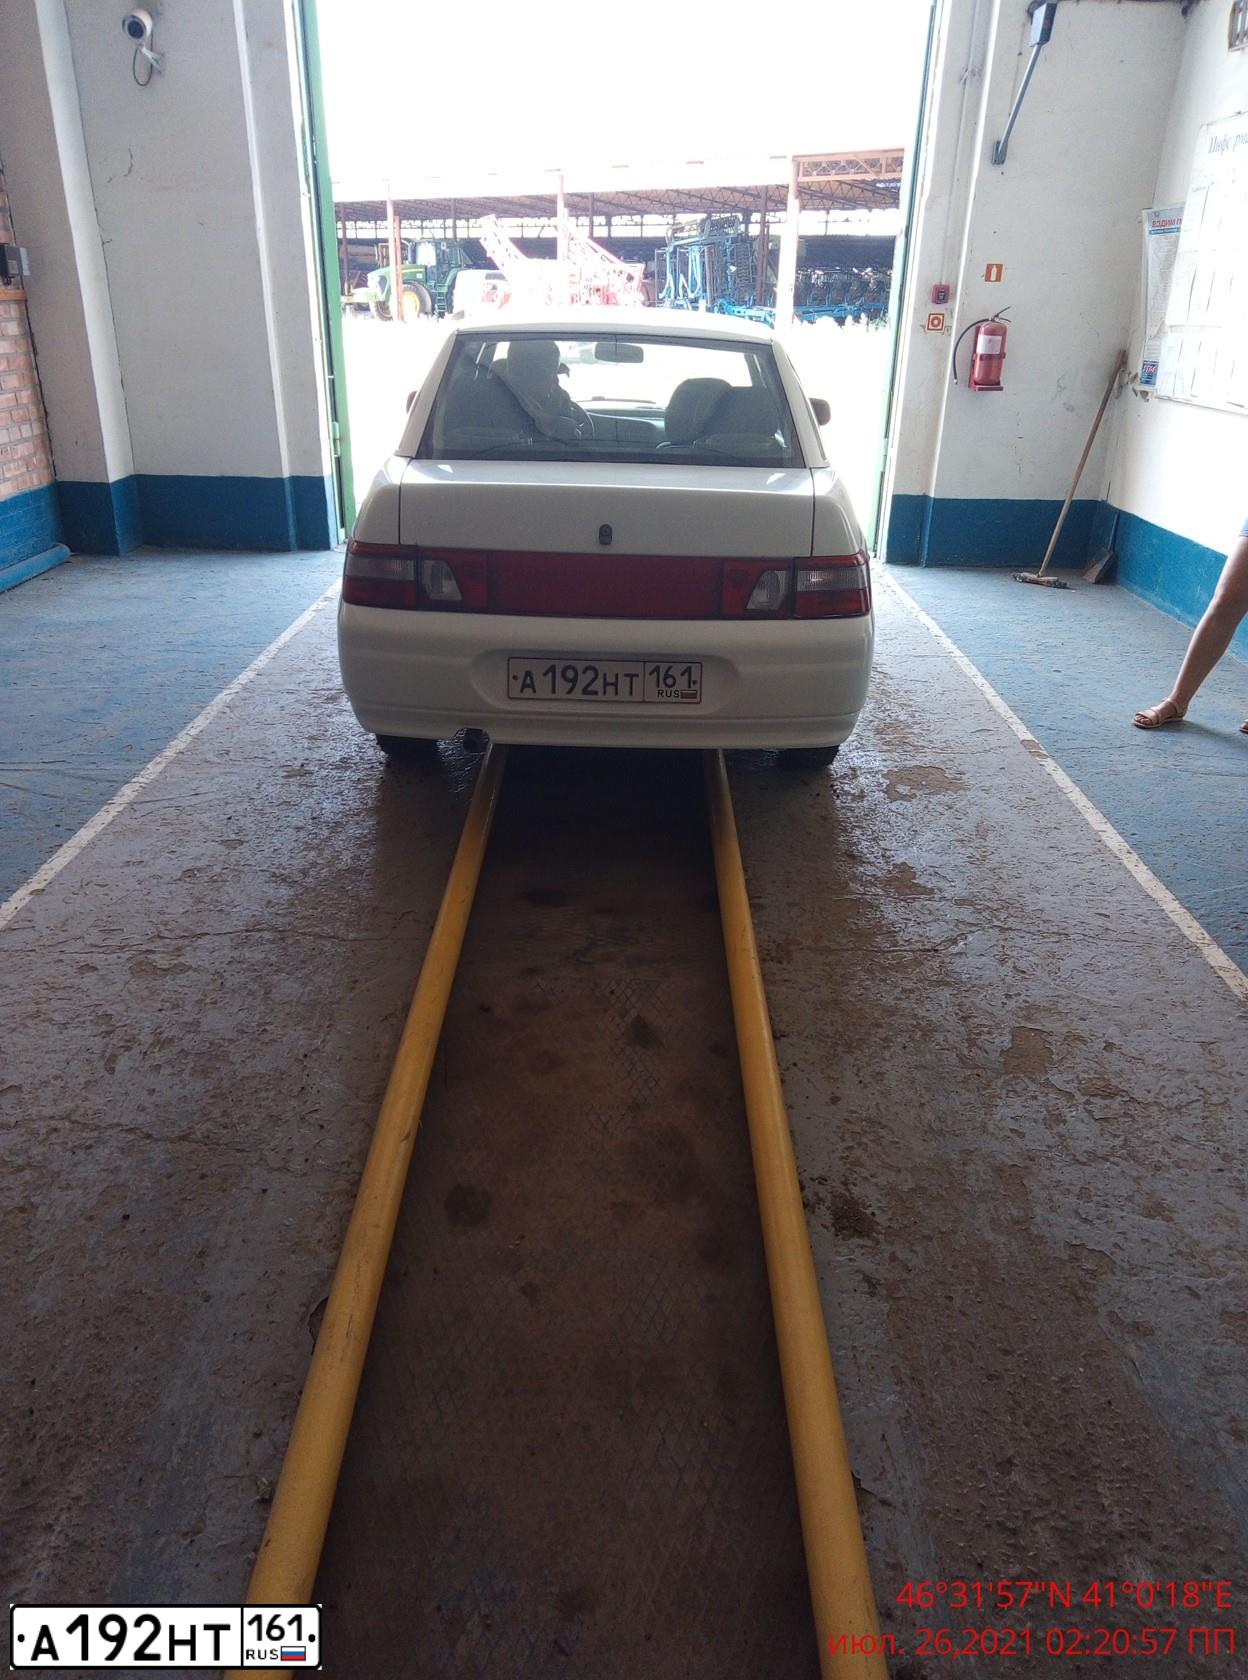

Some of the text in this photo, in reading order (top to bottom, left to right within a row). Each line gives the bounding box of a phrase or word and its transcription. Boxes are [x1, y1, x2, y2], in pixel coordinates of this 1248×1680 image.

[519, 663, 693, 697] А192НТ 161
[657, 689, 681, 699] RUS
